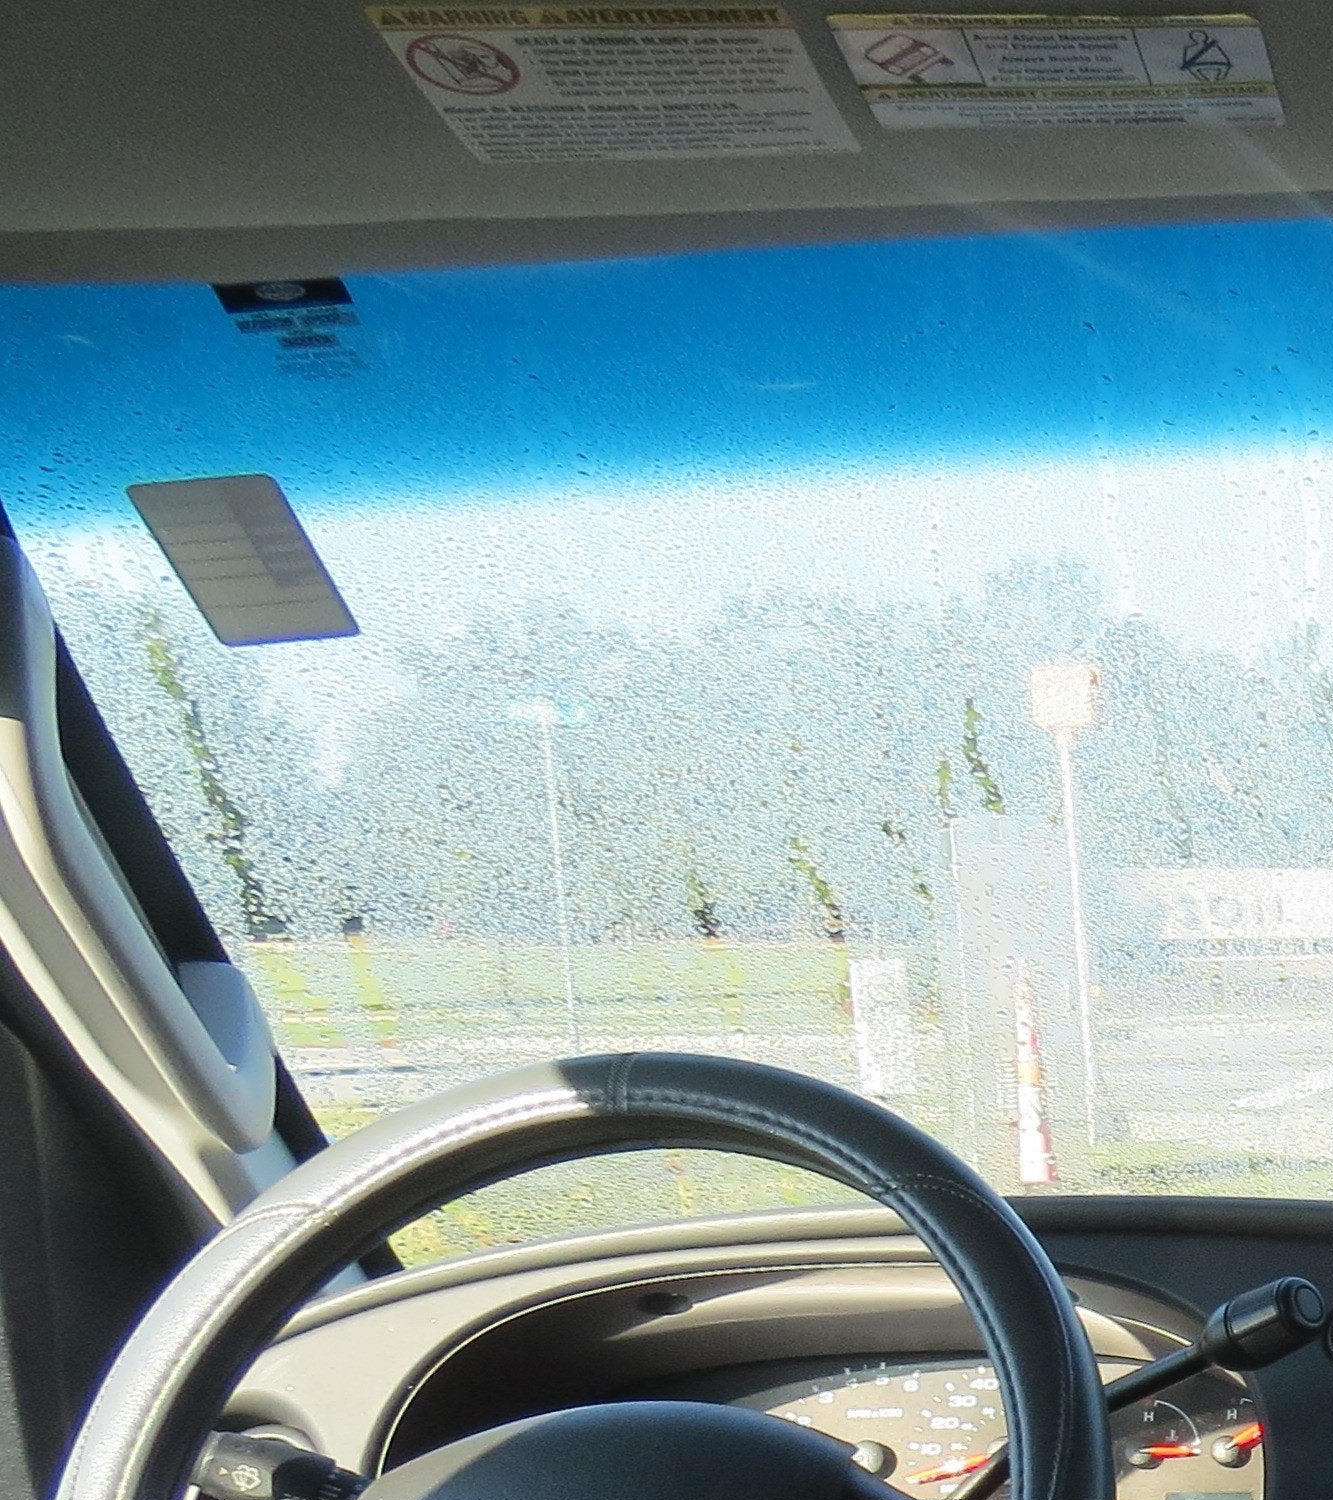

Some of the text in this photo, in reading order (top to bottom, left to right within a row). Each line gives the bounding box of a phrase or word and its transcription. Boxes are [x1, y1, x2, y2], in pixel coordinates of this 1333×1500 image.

[398, 10, 530, 24] WARNING
[948, 1394, 977, 1407] 30
[1143, 1411, 1155, 1422] H
[1227, 1408, 1238, 1420] H
[930, 1416, 960, 1429] 20
[921, 1442, 942, 1455] 10
